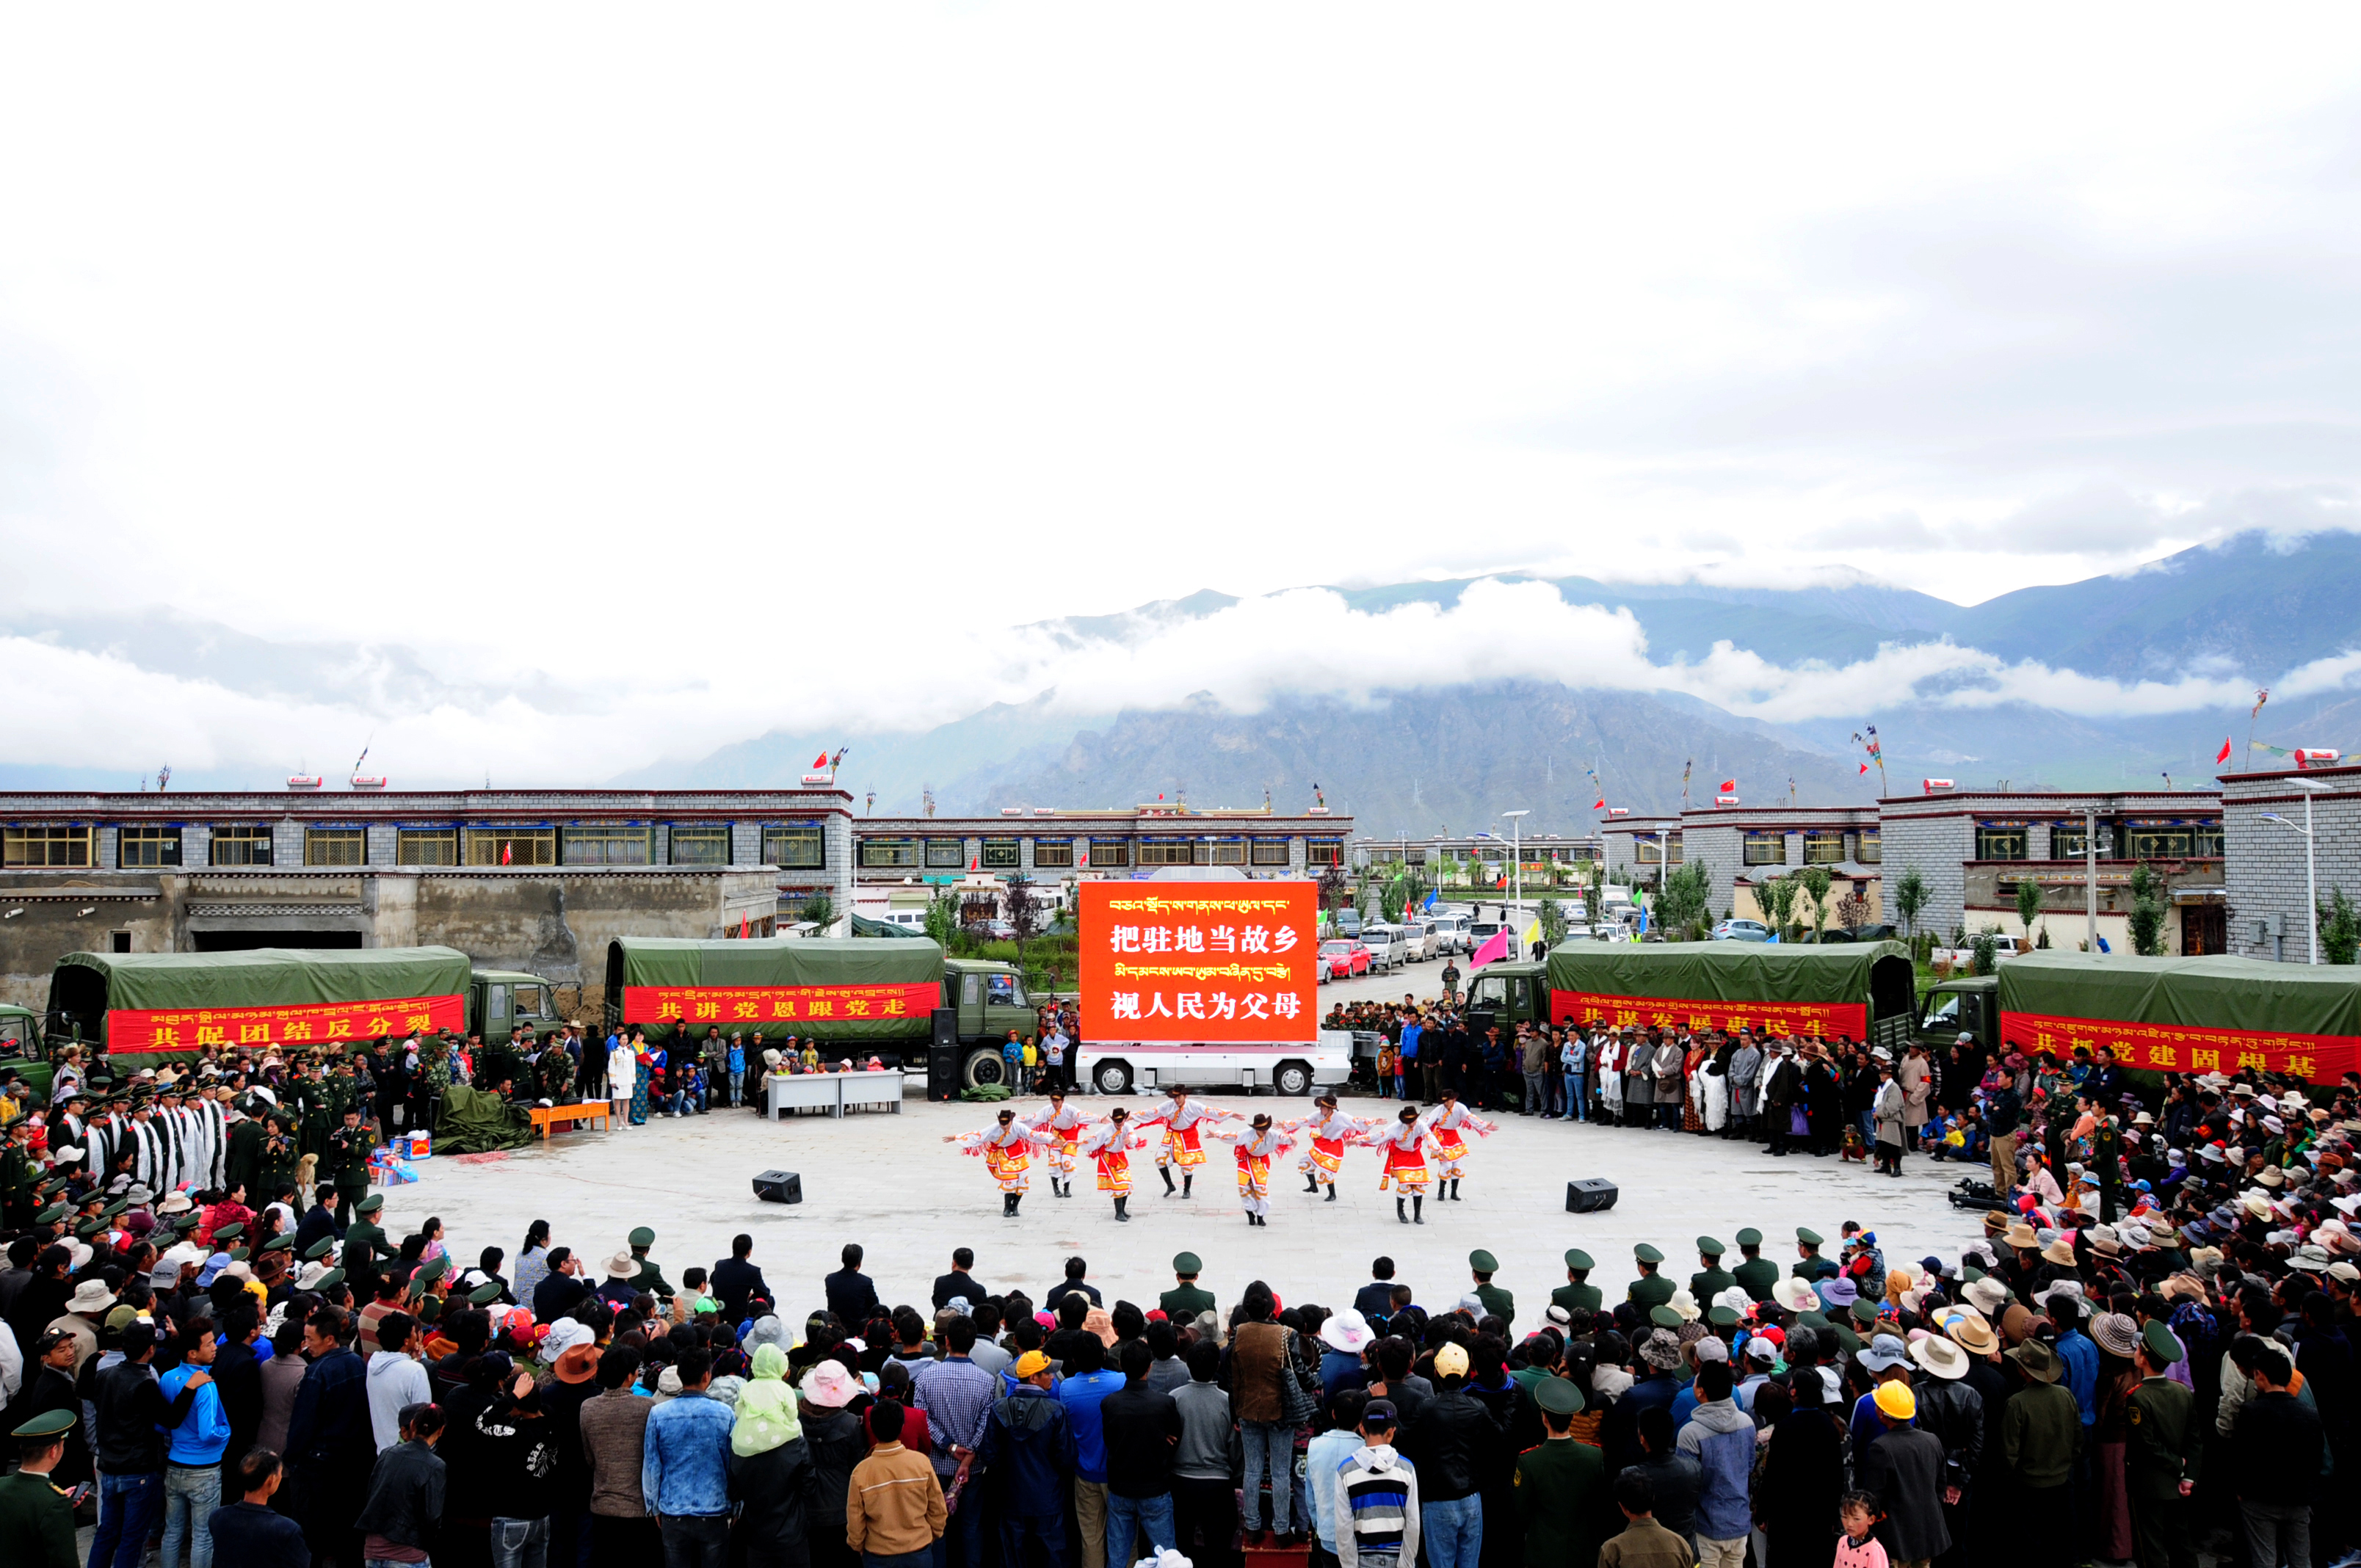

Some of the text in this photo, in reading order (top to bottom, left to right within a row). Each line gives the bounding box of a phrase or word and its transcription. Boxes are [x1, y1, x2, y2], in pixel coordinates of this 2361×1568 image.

[1109, 924, 1299, 954] 把驻地当故乡
[656, 999, 906, 1020] 共讲党恩跟党走
[1109, 991, 1302, 1020] 视人民为父母
[148, 1014, 432, 1048] 共促团结反分裂
[1580, 1007, 1830, 1037] 共谋发展惠民生
[2031, 1033, 2317, 1078] 共抓党建固根基
